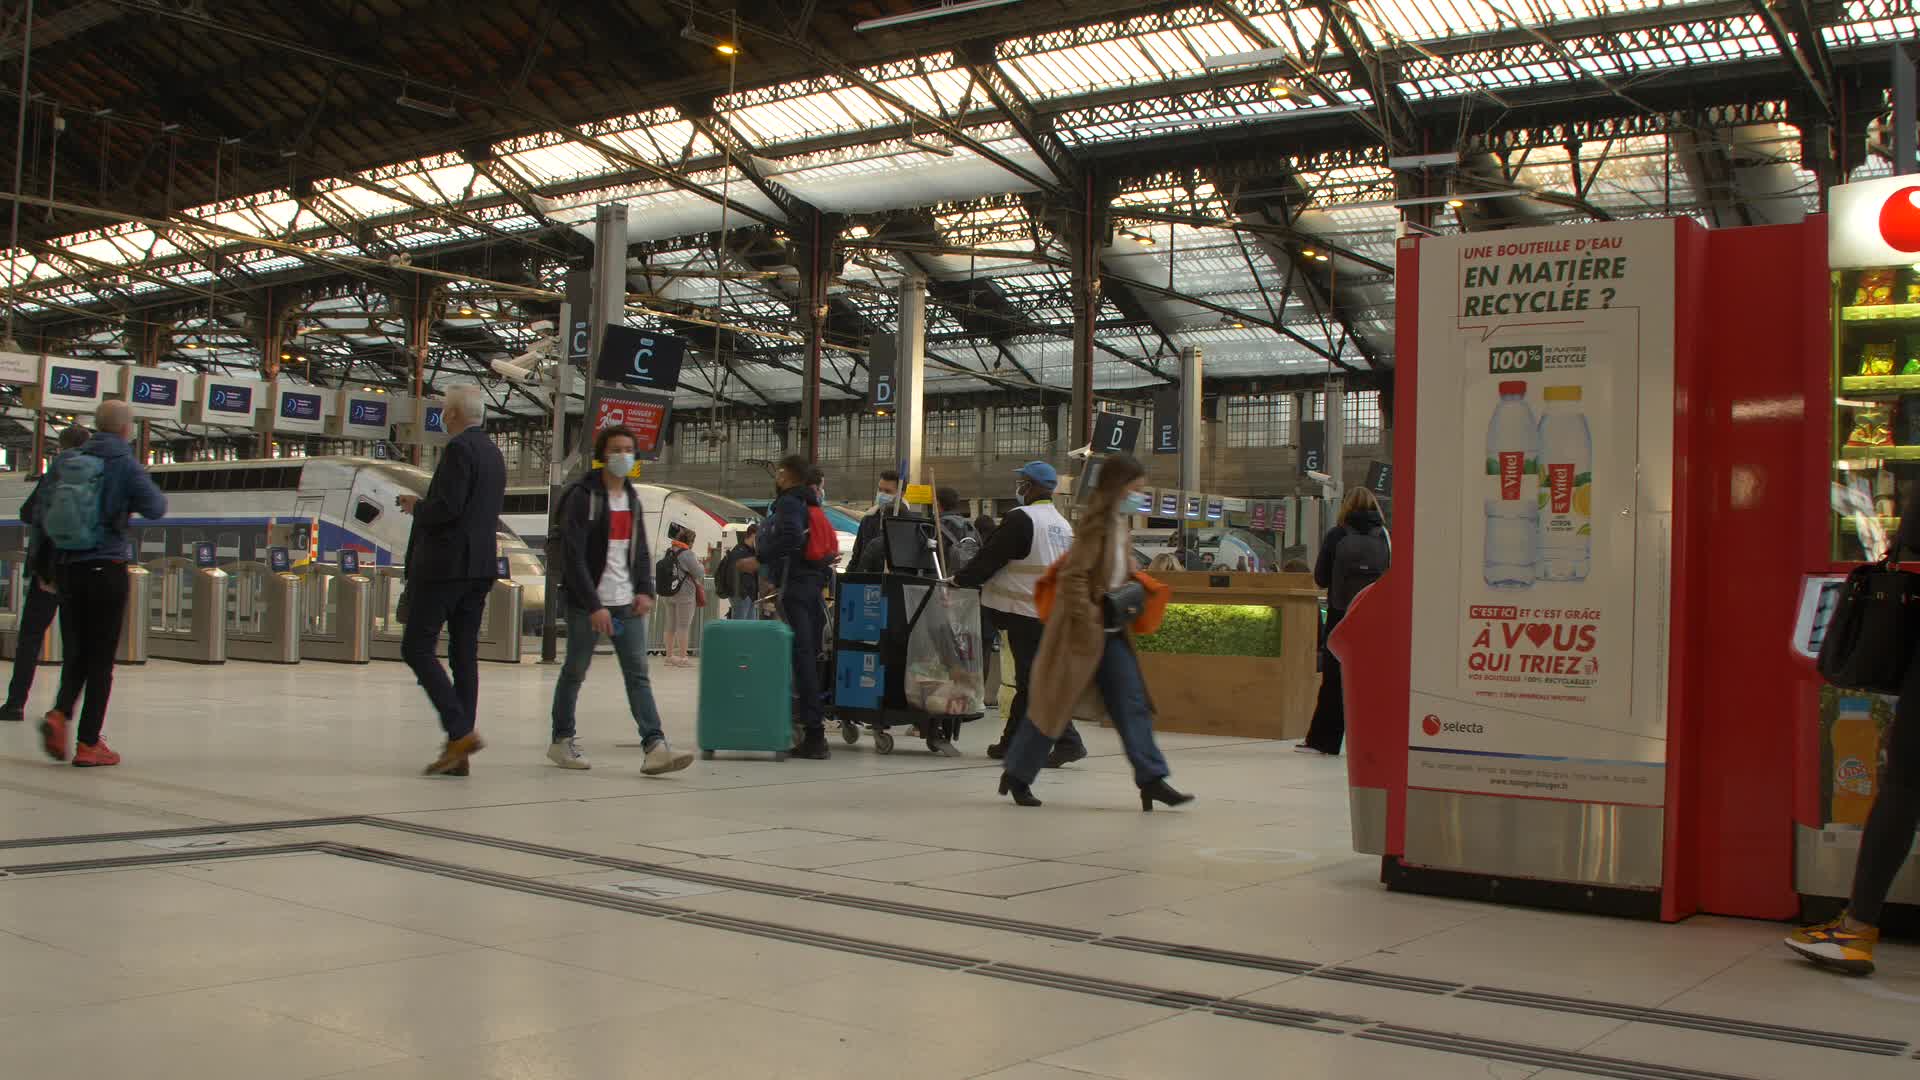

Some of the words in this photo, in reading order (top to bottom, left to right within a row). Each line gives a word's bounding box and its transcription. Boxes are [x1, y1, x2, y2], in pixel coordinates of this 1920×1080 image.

[1463, 245, 1493, 260] UNE
[1496, 240, 1571, 257] BOUTEILLE
[1575, 237, 1623, 252] D'EAU
[1464, 265, 1499, 288] EN
[1508, 251, 1627, 285] MATIÈRE
[1463, 283, 1590, 317] RECYCLÉE
[1600, 288, 1616, 310] ?
[634, 348, 653, 374] C
[1492, 350, 1541, 370] 100%
[877, 382, 891, 401] D
[1111, 427, 1123, 446] D
[1162, 431, 1172, 447] E
[1306, 456, 1317, 470] G
[1471, 606, 1499, 618] C'EST
[1501, 607, 1515, 618] ICI
[1519, 609, 1532, 619] ET
[1534, 609, 1561, 620] C'EST
[1564, 607, 1602, 621] GRÂCE
[1468, 652, 1511, 673] QUI
[1519, 654, 1582, 675] TRIEZ
[1443, 719, 1484, 735] selecta
